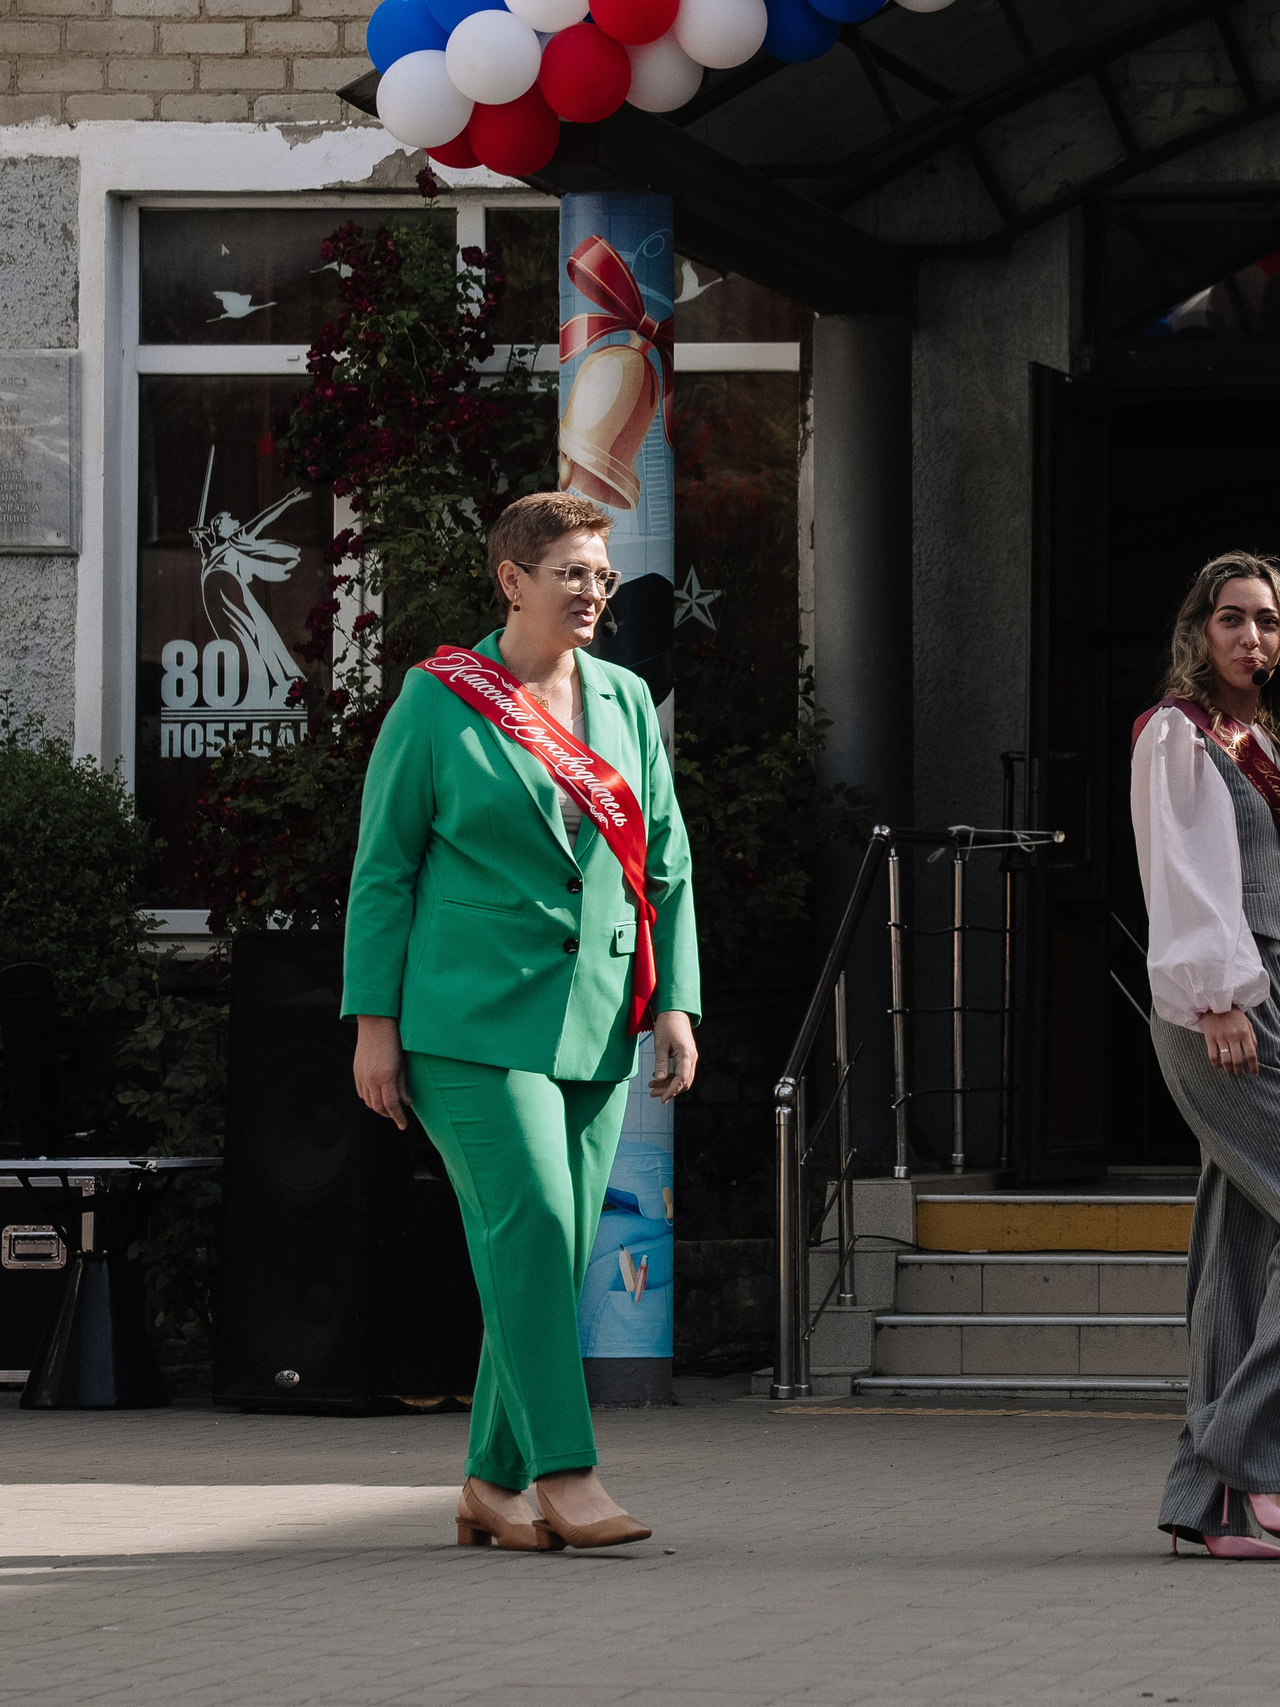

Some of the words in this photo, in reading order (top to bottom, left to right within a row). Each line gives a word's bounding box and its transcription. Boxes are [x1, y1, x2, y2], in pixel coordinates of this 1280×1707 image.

[161, 639, 240, 708] 80
[425, 652, 538, 723] Классный
[501, 714, 628, 827] руководитель
